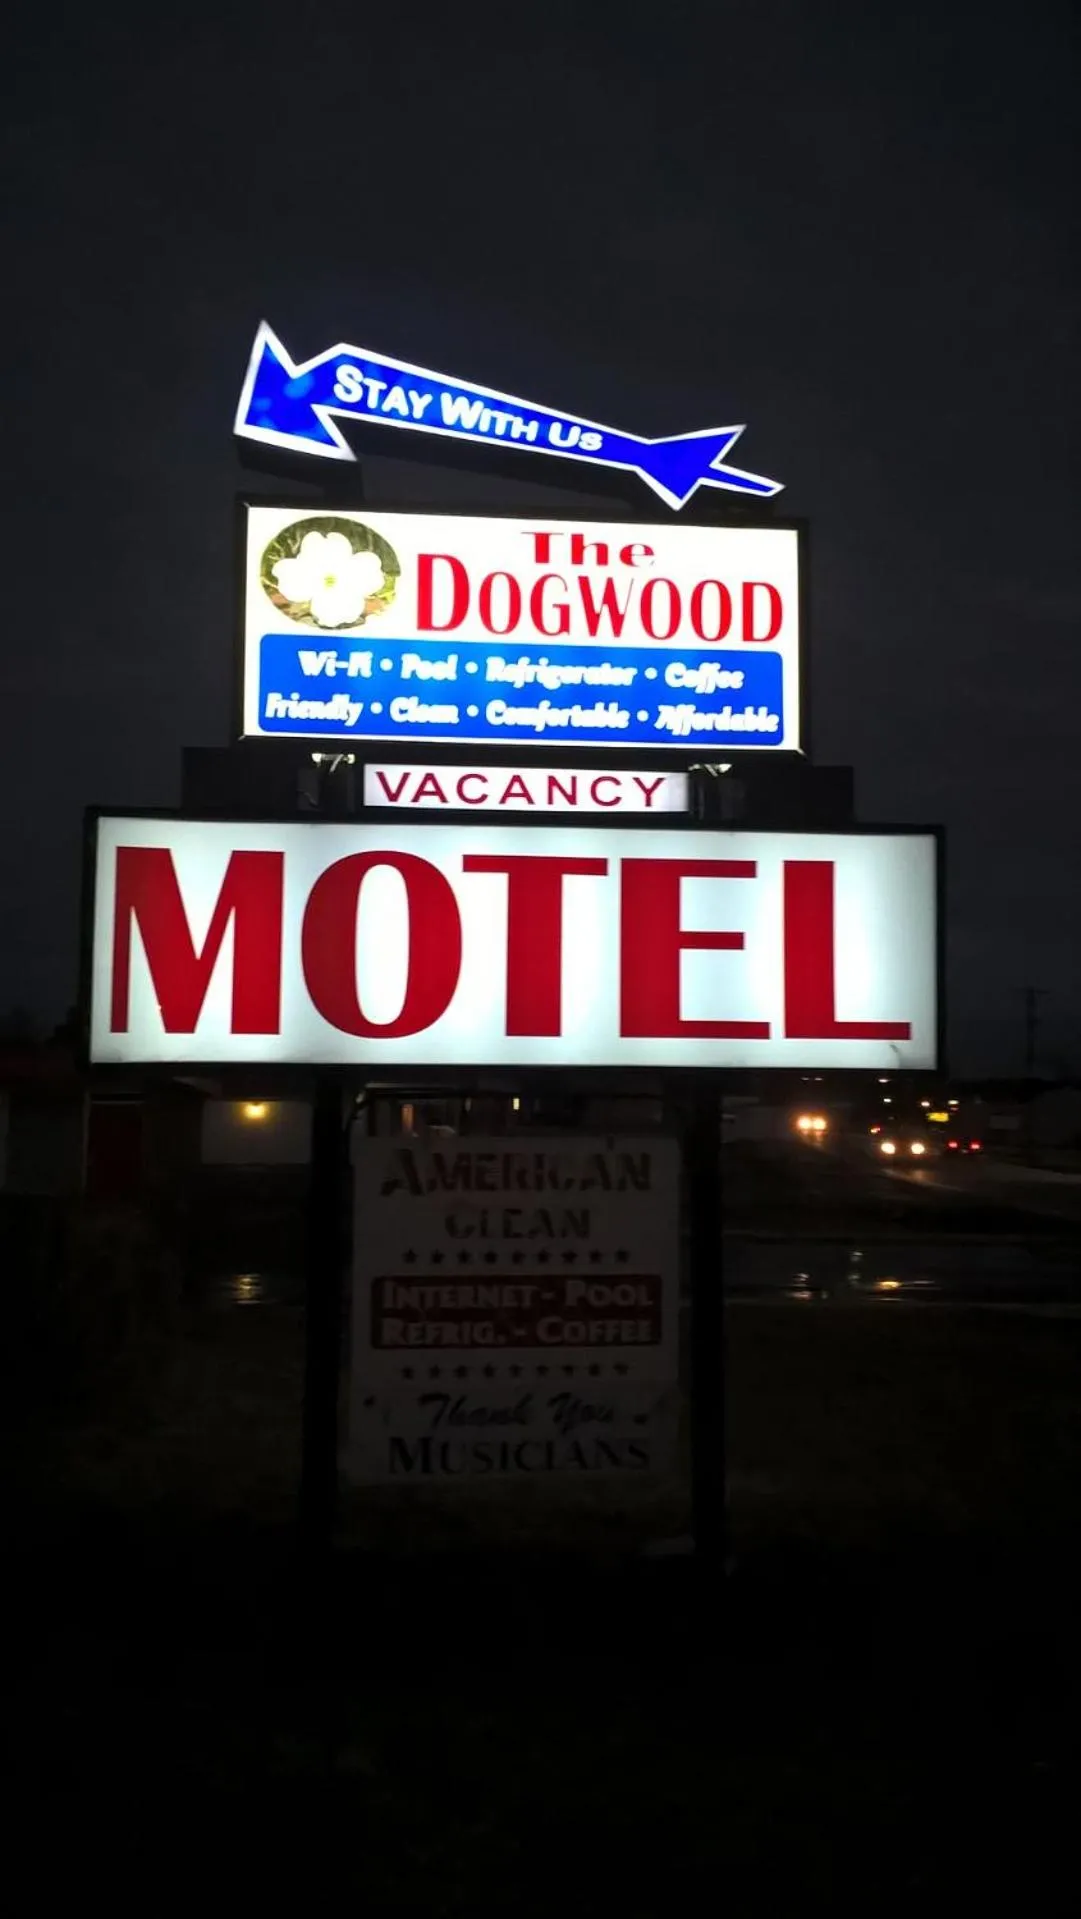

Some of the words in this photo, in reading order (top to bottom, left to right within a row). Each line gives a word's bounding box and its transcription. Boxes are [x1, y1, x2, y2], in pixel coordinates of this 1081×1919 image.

[333, 363, 433, 418] STAY
[440, 396, 538, 441] WITH
[520, 530, 656, 568] The
[416, 552, 784, 643] DOGWOOD
[298, 650, 373, 678] Wi-Fi
[400, 653, 459, 681] Pool
[485, 656, 638, 690] Refrigerator
[664, 662, 745, 694] Coffee
[264, 692, 364, 727] Friendly
[389, 696, 460, 724] Clean
[485, 699, 631, 732] Comfortable
[653, 704, 780, 736] Affordable
[374, 771, 667, 807] VACANCY
[110, 846, 912, 1040] MOTEL
[380, 1149, 653, 1196] AMERICAN
[444, 1208, 591, 1239] CLEAN
[565, 1279, 653, 1307] POOL
[536, 1316, 653, 1344] COFFEE
[388, 1437, 649, 1474] MUSICIANS
